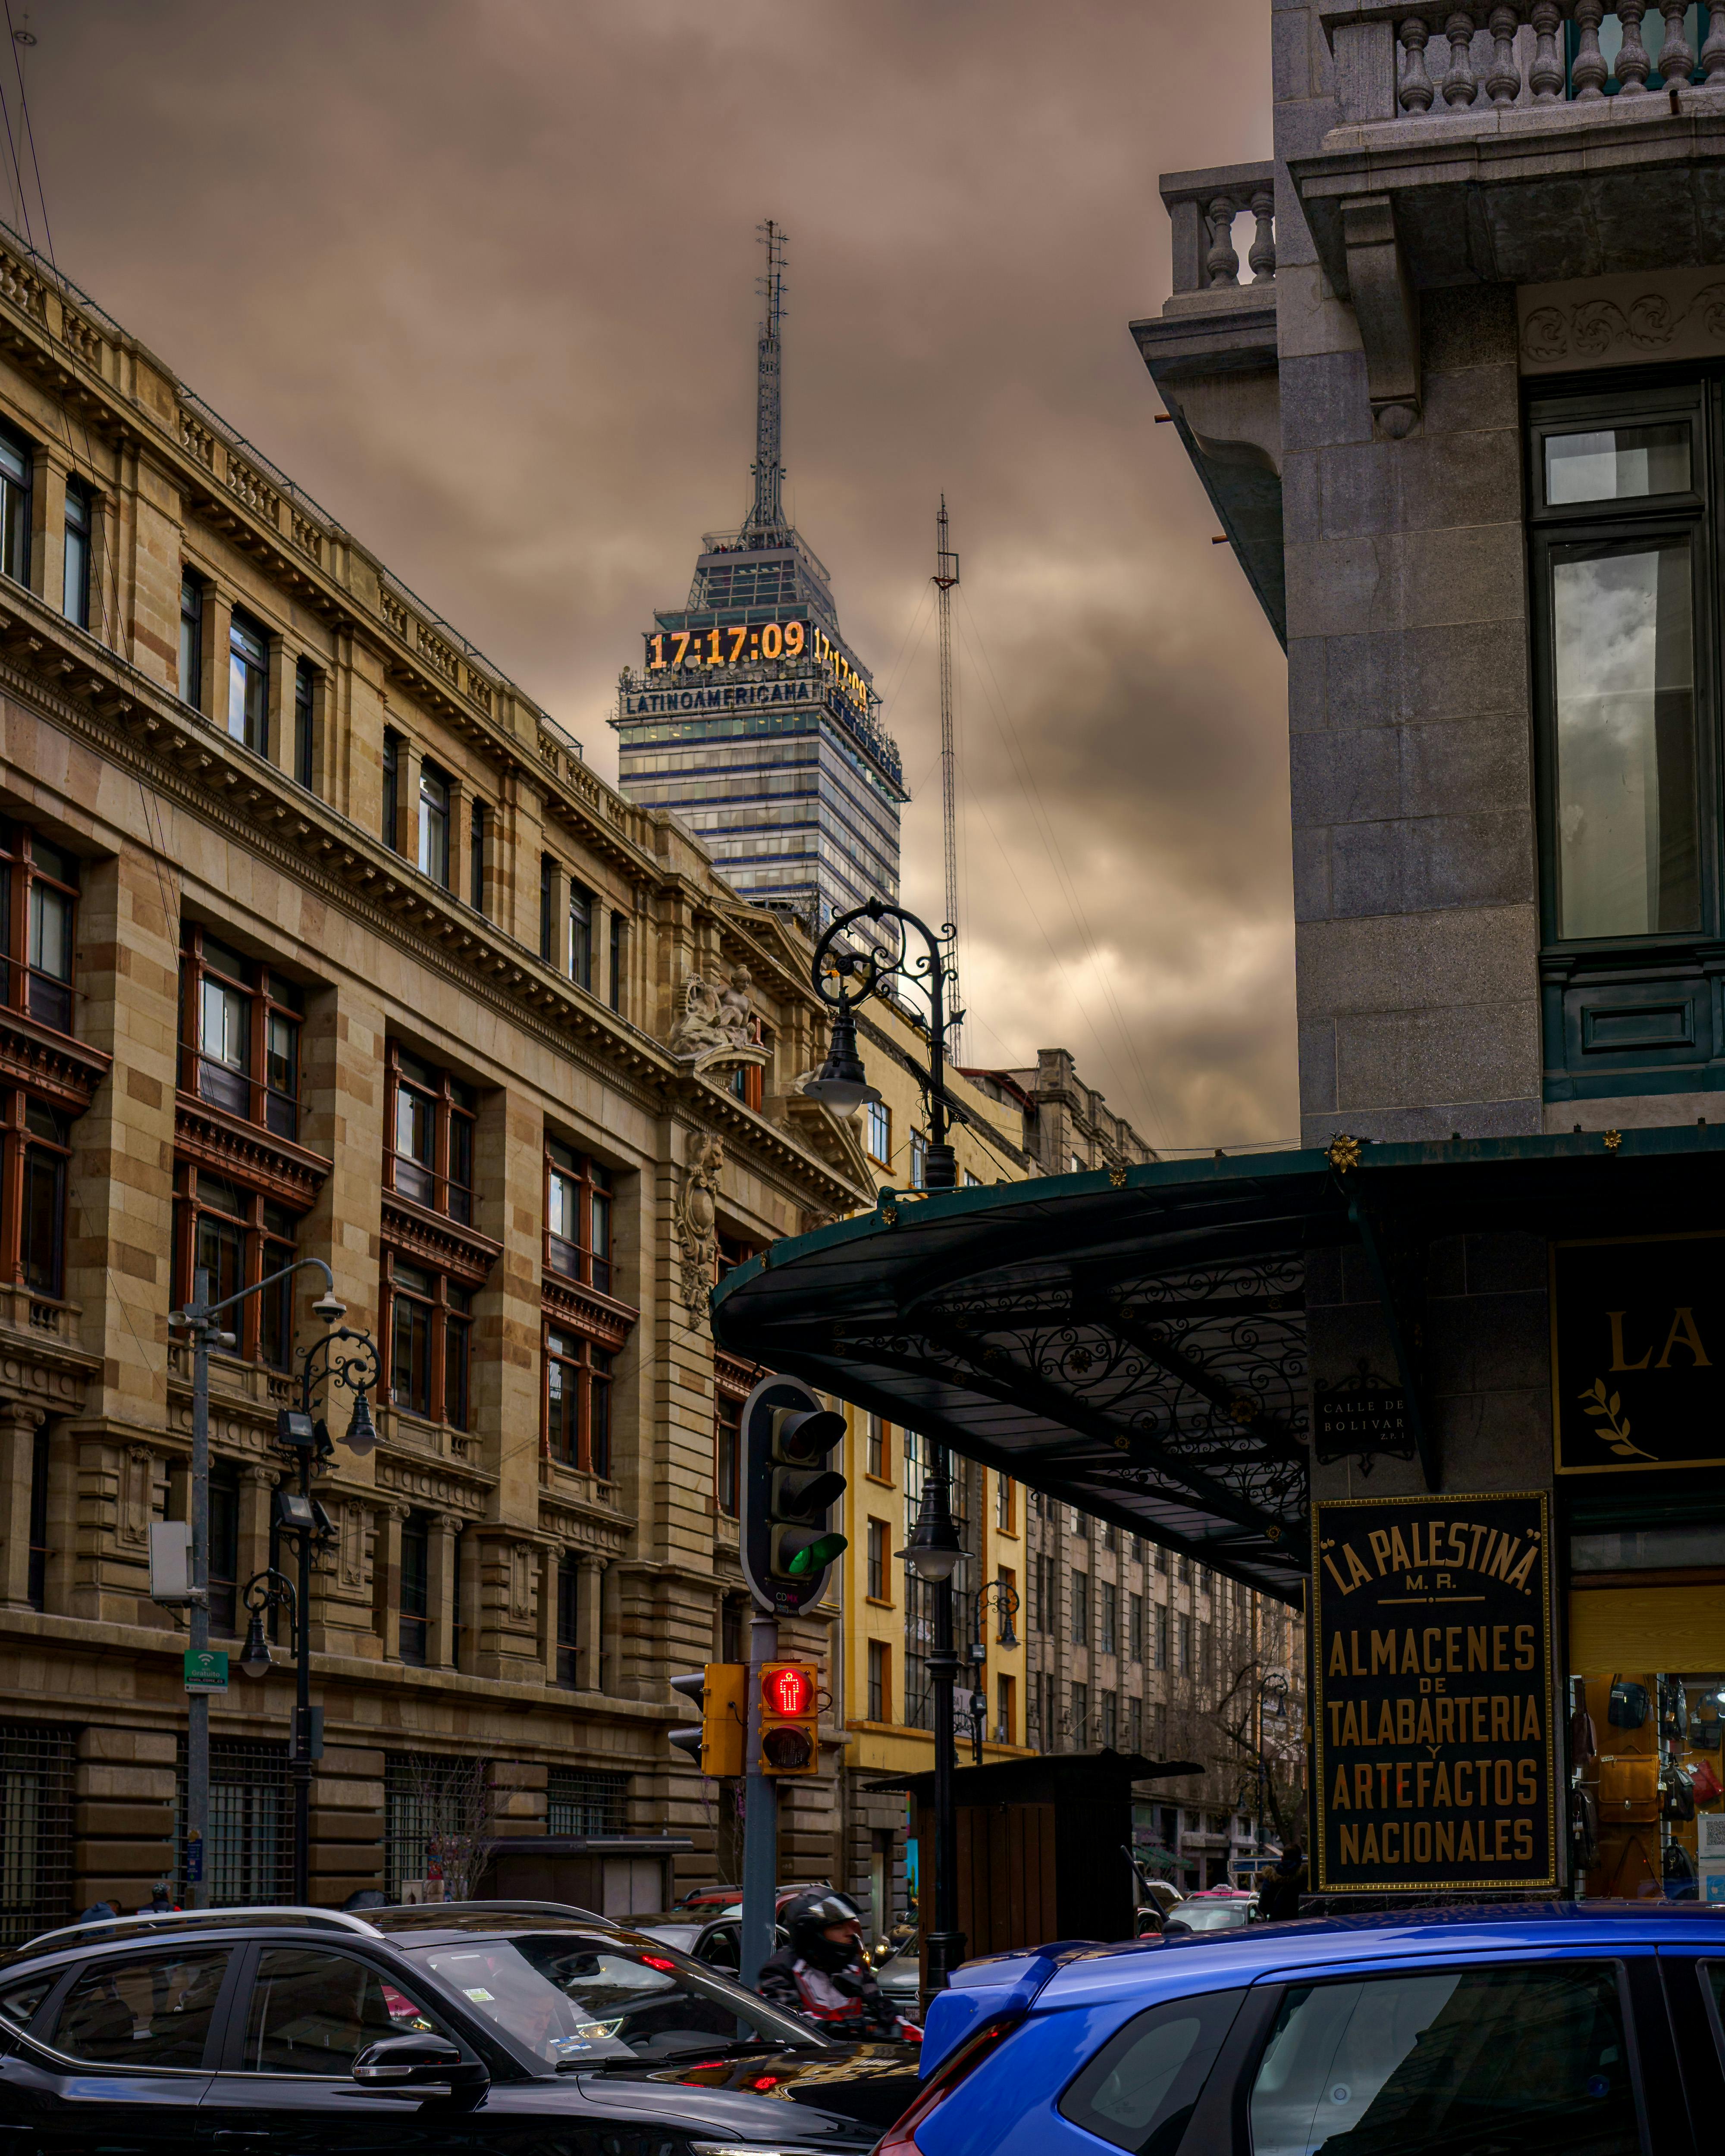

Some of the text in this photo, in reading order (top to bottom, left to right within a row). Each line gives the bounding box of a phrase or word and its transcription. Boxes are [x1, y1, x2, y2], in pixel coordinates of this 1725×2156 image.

[650, 621, 804, 669] 17:17:09
[627, 681, 810, 714] LATINOAMERICANA
[1605, 1307, 1713, 1372] LA
[1324, 1400, 1404, 1413] CALLE DE
[1324, 1418, 1404, 1432] BOLIVAR
[776, 1592, 799, 1603] CDMX
[1406, 1573, 1456, 1590] M. R.
[1329, 1625, 1534, 1677] ALMACENES
[1419, 1677, 1446, 1693] DE
[1327, 1695, 1541, 1746] TALABARTERIA
[1426, 1745, 1442, 1759] Y
[1332, 1759, 1537, 1810] ARTEFACTOS
[1340, 1819, 1533, 1865] NACIONALES
